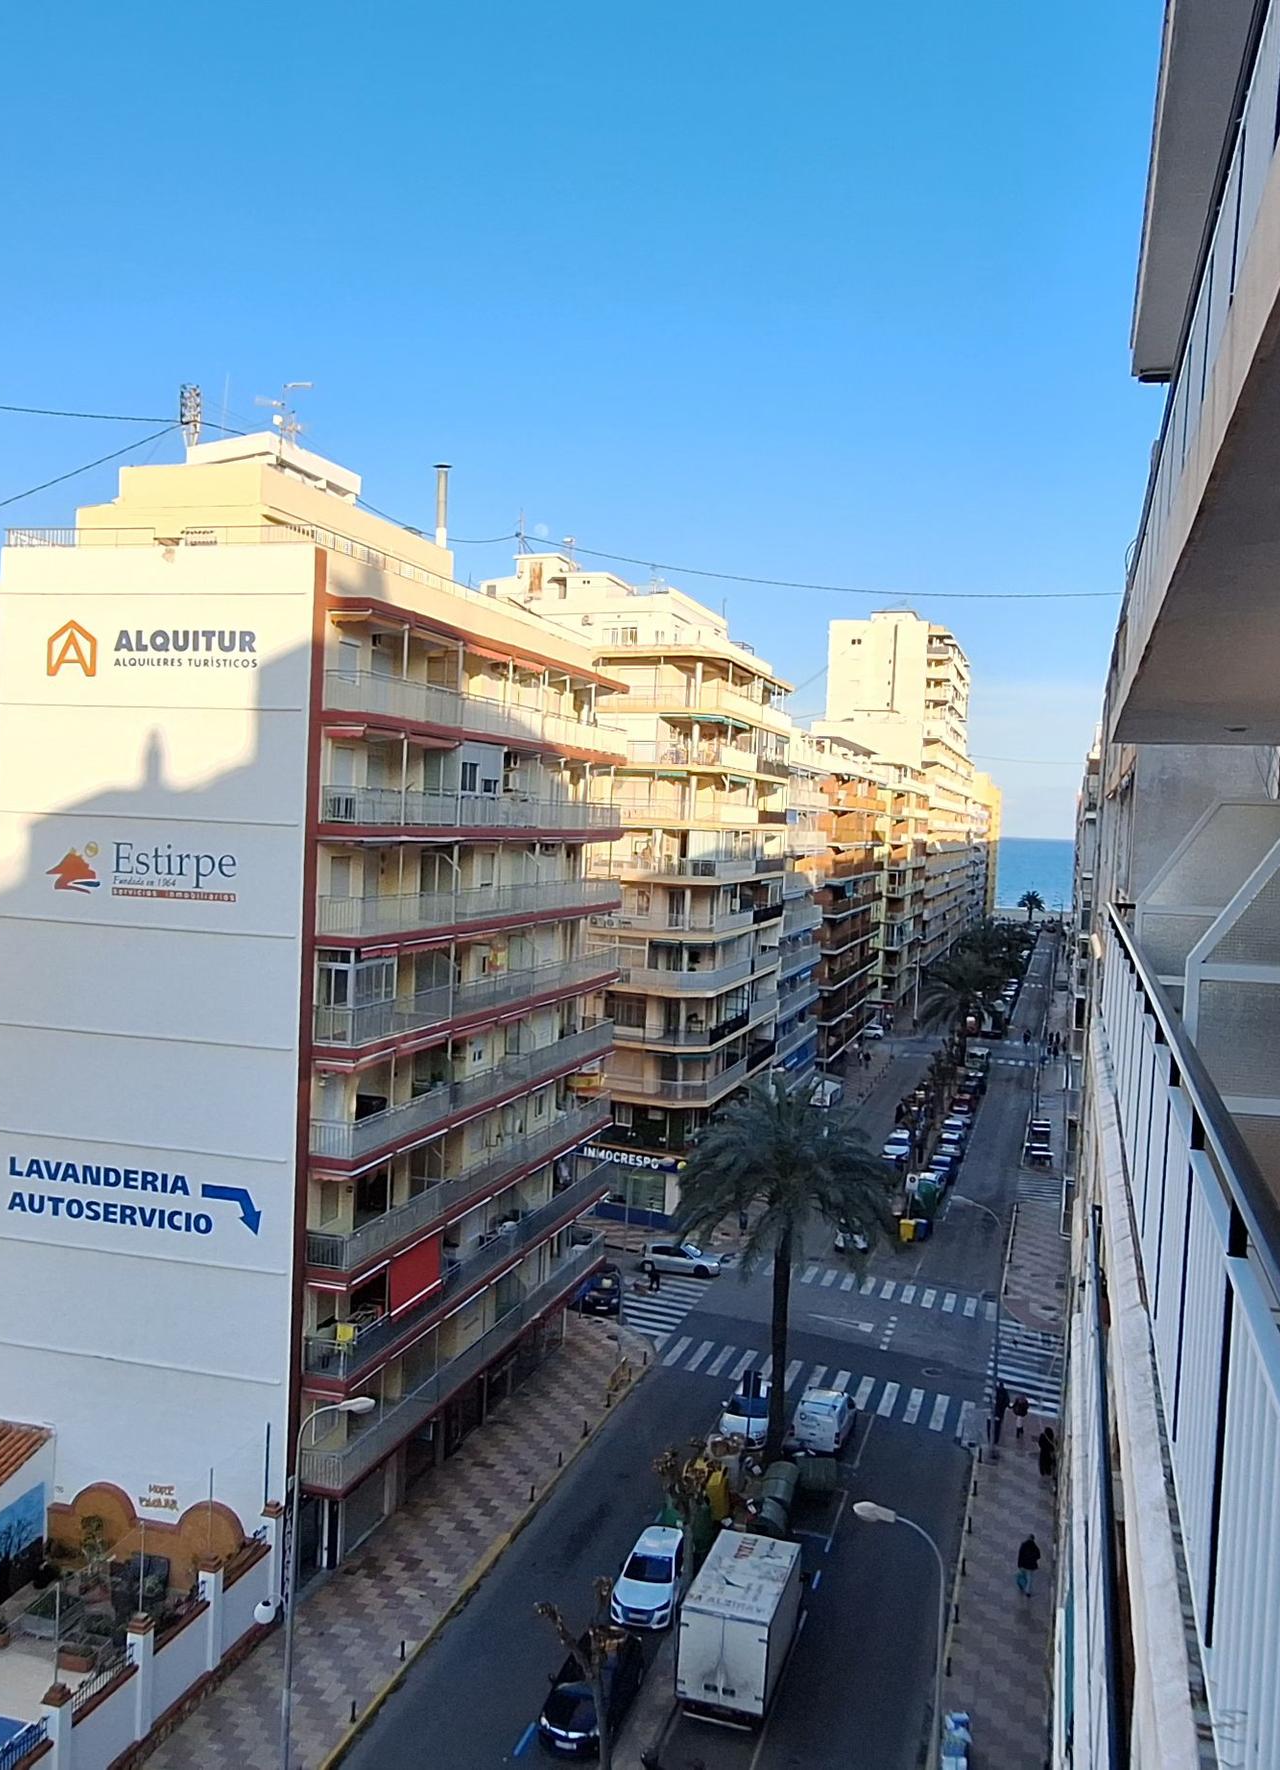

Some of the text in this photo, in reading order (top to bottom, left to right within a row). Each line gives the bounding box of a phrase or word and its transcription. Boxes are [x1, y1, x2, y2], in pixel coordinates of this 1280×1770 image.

[114, 629, 256, 653] ALQUITUR
[114, 657, 182, 667] ALQUILERES
[112, 841, 237, 888] Estirpe
[583, 1146, 660, 1169] INMOCRESPO
[9, 1156, 190, 1196] LAVANDERIA
[8, 1191, 213, 1234] AUTOSERVICIO
